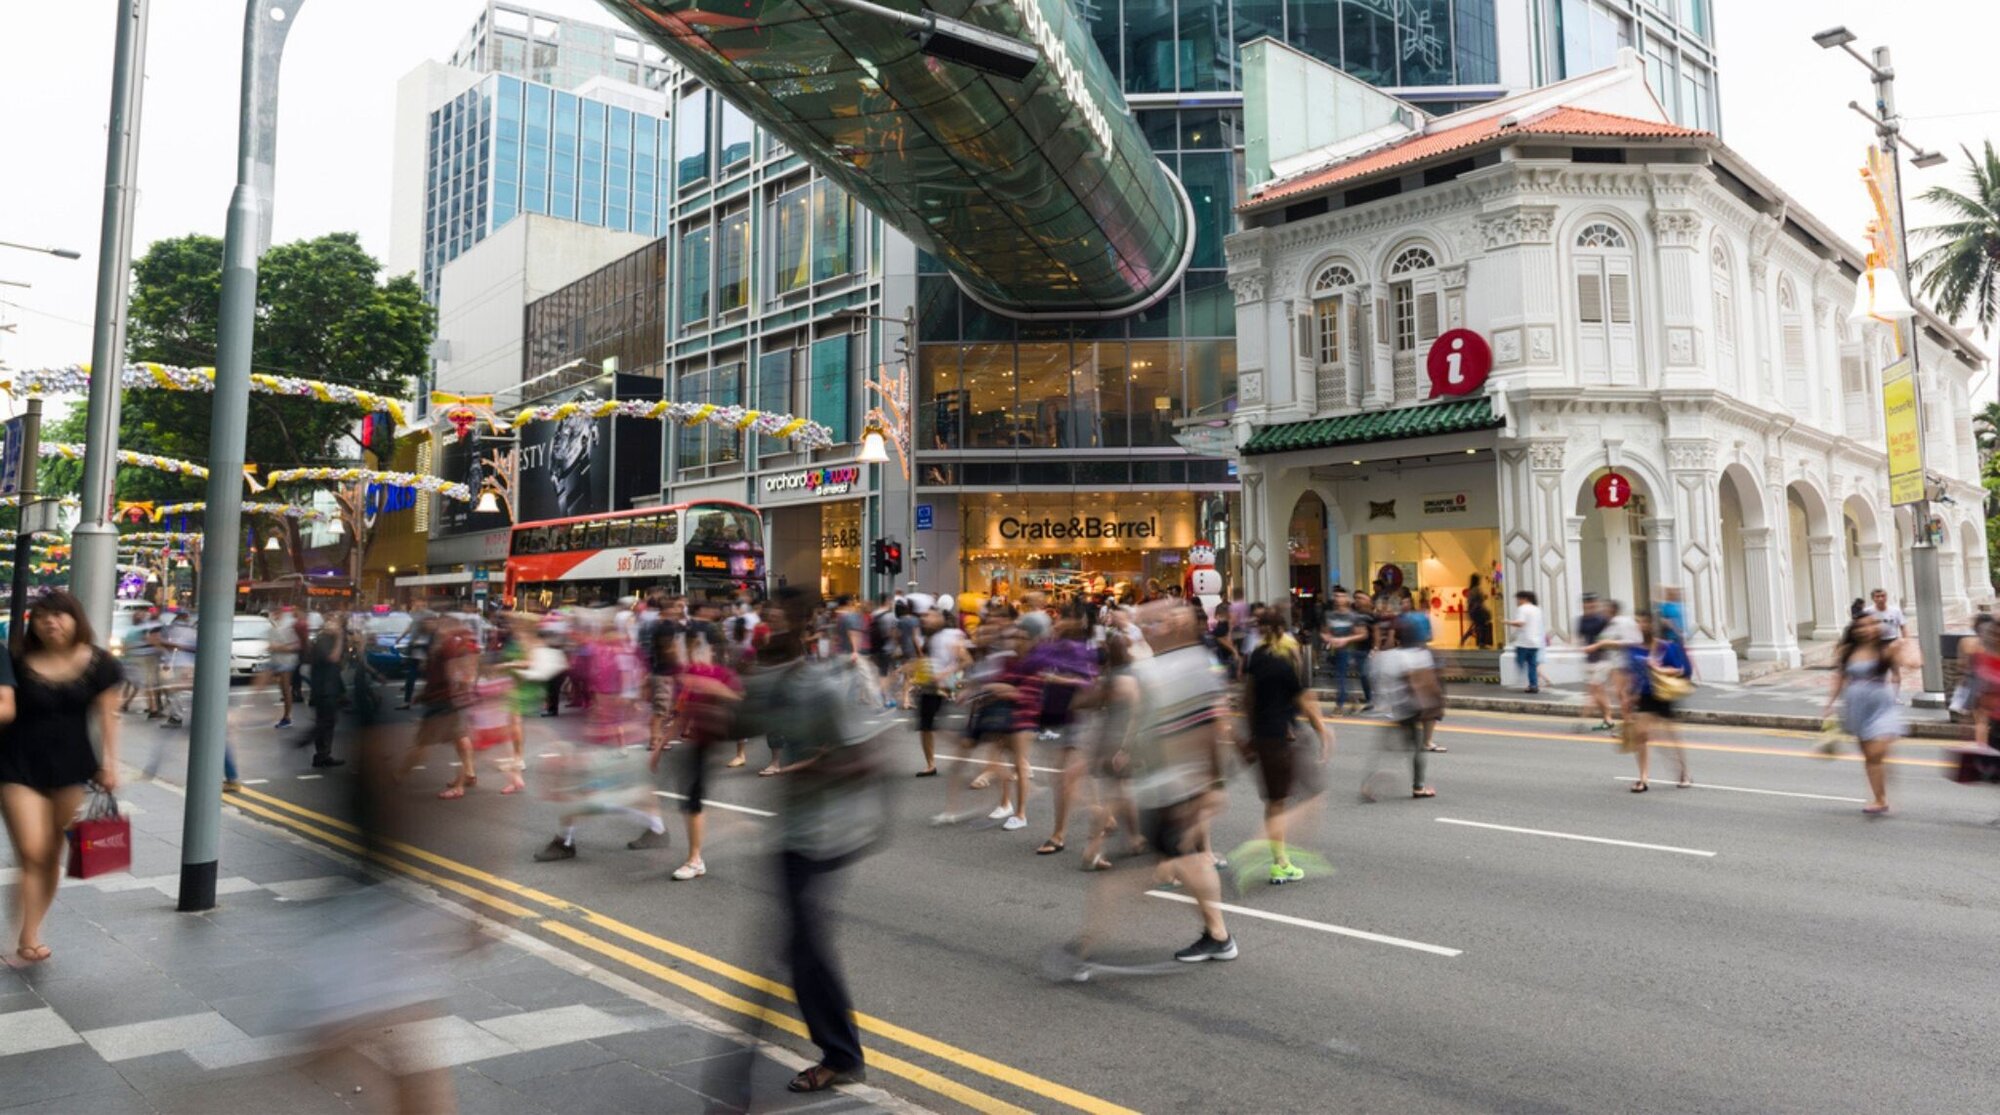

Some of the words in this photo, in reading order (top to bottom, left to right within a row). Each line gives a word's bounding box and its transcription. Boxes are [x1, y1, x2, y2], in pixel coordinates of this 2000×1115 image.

[999, 516, 1156, 539] Crate&Barrel
[616, 555, 632, 572] SBS
[632, 552, 665, 571] Transit
